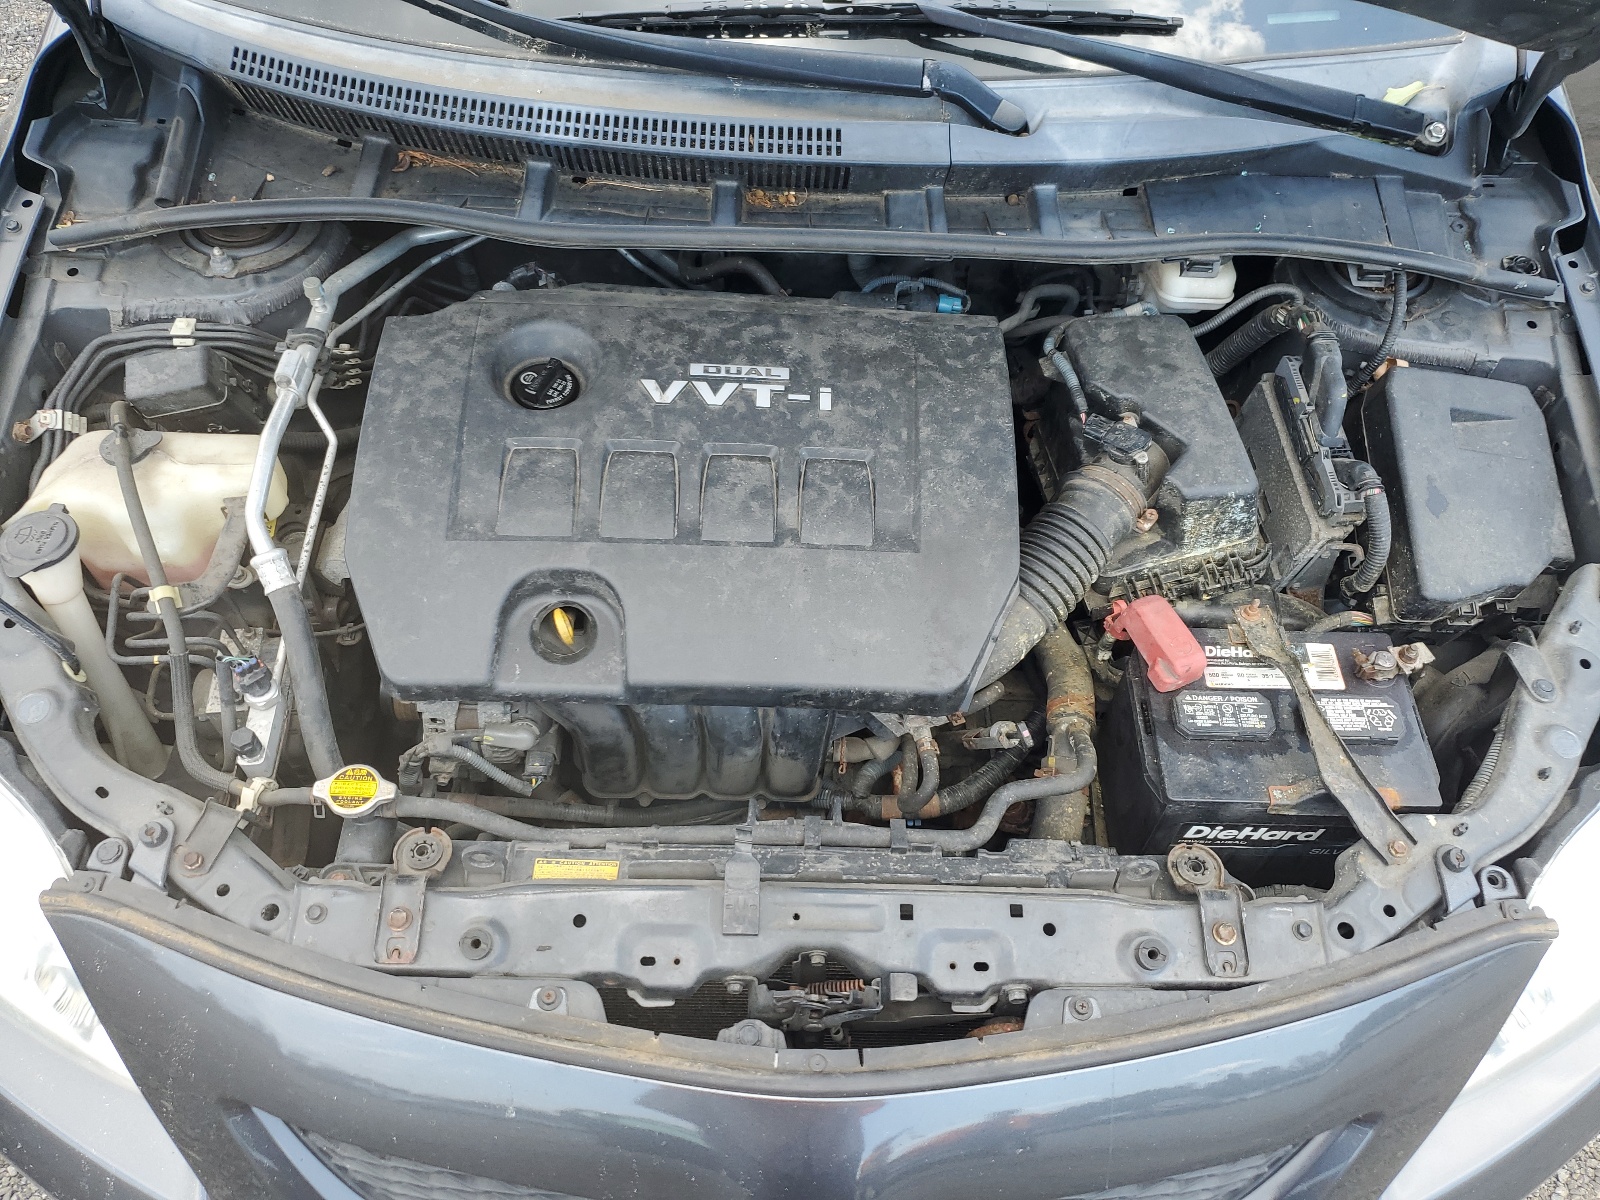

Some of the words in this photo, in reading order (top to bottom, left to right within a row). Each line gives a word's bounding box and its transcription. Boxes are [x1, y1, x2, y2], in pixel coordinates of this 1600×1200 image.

[703, 365, 781, 378] DUAL
[640, 378, 832, 411] VVT-i
[1204, 645, 1256, 658] DieHa
[1192, 694, 1223, 702] DANGER
[1230, 695, 1258, 703] POISON
[1183, 825, 1327, 841] DieHard
